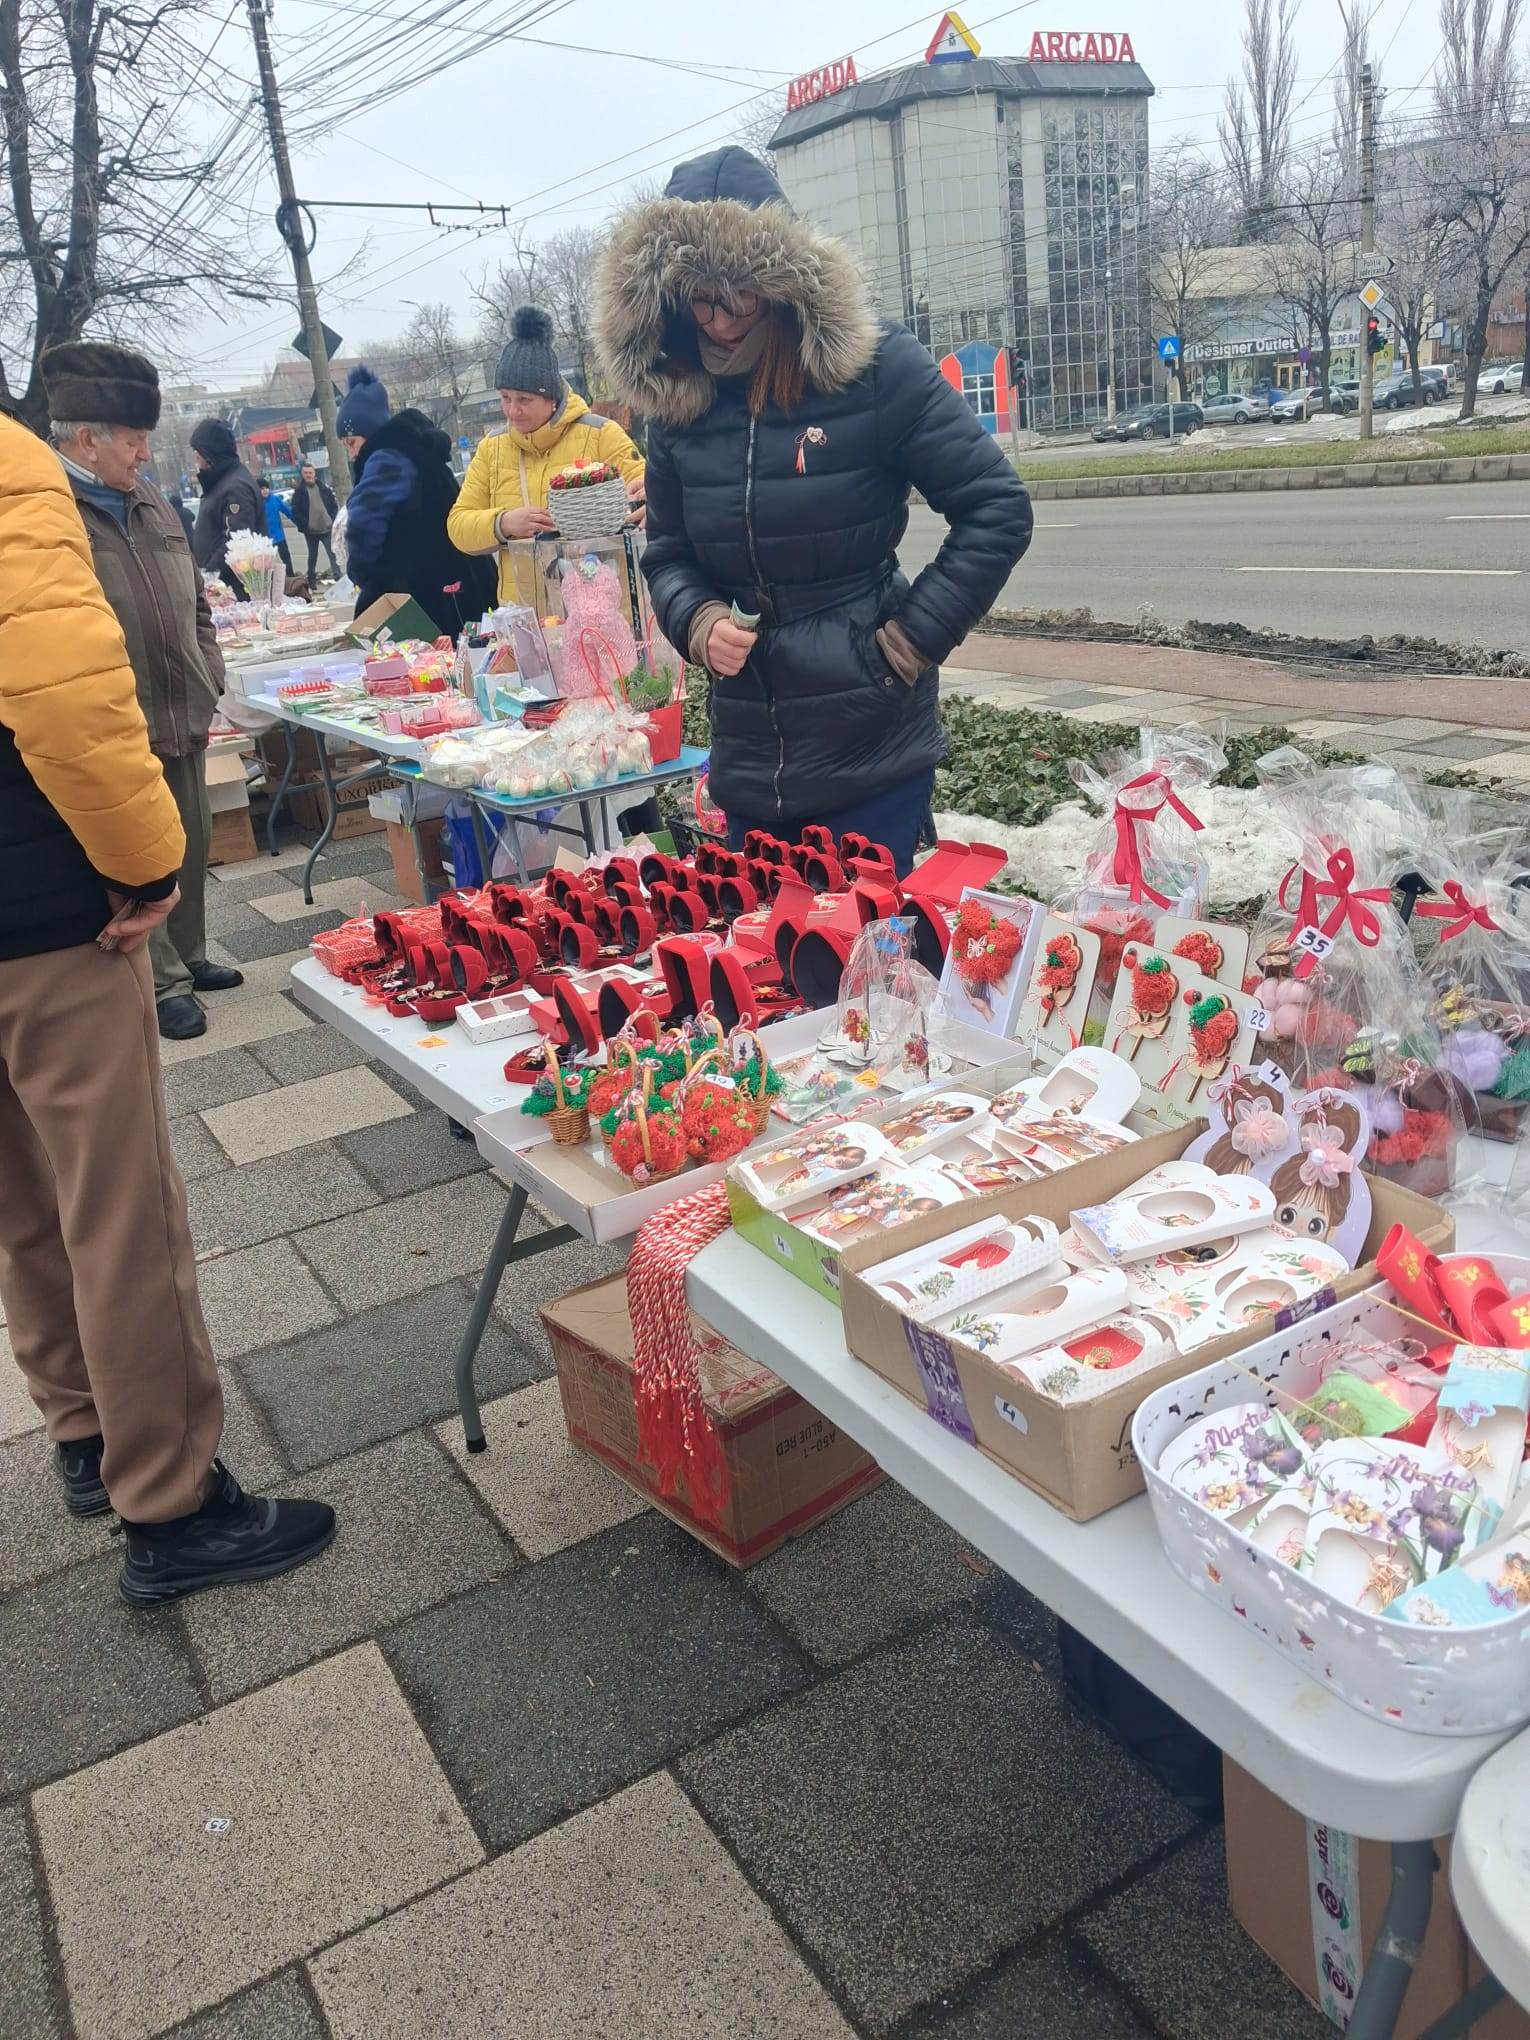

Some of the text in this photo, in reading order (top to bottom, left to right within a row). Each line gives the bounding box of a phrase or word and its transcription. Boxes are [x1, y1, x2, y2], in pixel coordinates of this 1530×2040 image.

[1028, 31, 1136, 63] ARCADA
[786, 55, 859, 112] ARCADA
[1195, 337, 1295, 360] Designer Outlet
[1300, 930, 1330, 953] 35
[1250, 1009, 1266, 1028] 22
[1270, 1066, 1281, 1083] 4
[777, 1235, 785, 1253] 4
[1001, 1401, 1017, 1423] 4
[776, 1419, 823, 1457] BLUE RED
